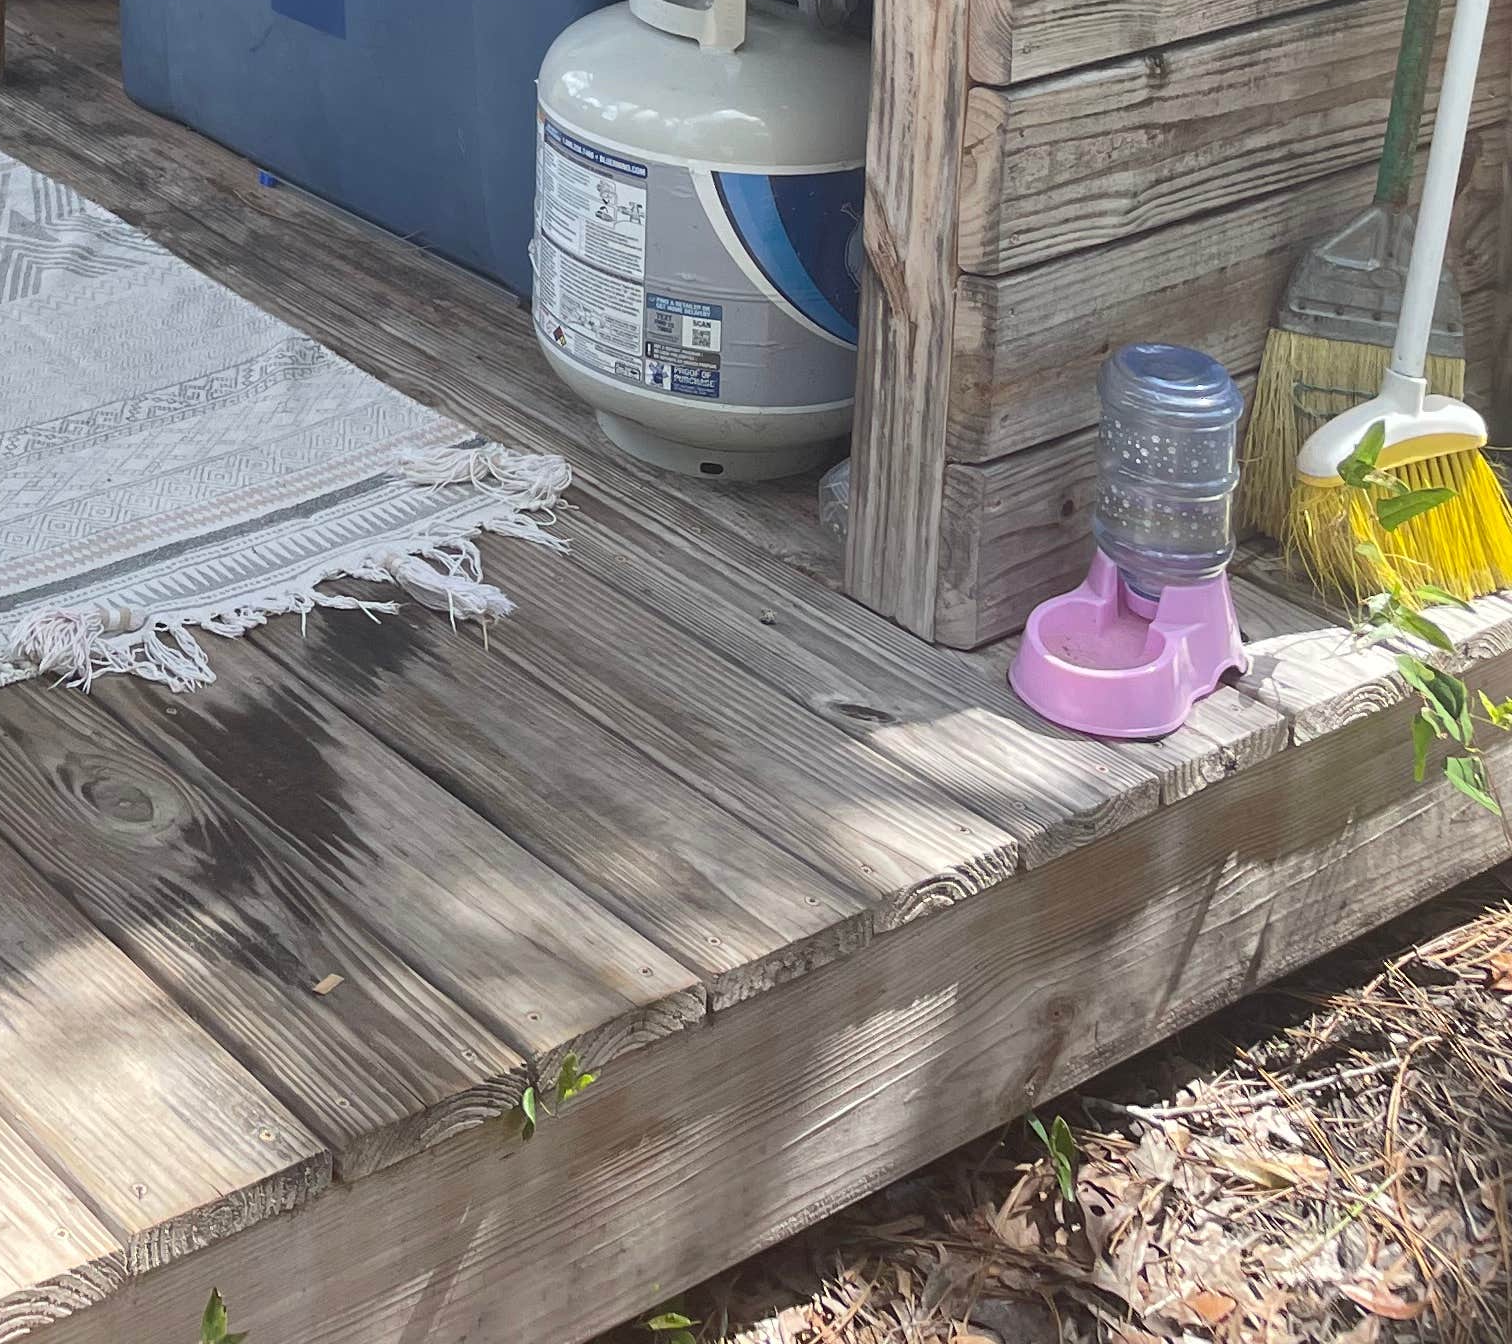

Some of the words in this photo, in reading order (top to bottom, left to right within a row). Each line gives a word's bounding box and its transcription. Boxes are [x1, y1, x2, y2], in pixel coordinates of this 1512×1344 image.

[692, 319, 711, 328] SCAN
[674, 366, 700, 377] PROOF
[701, 371, 712, 379] OF
